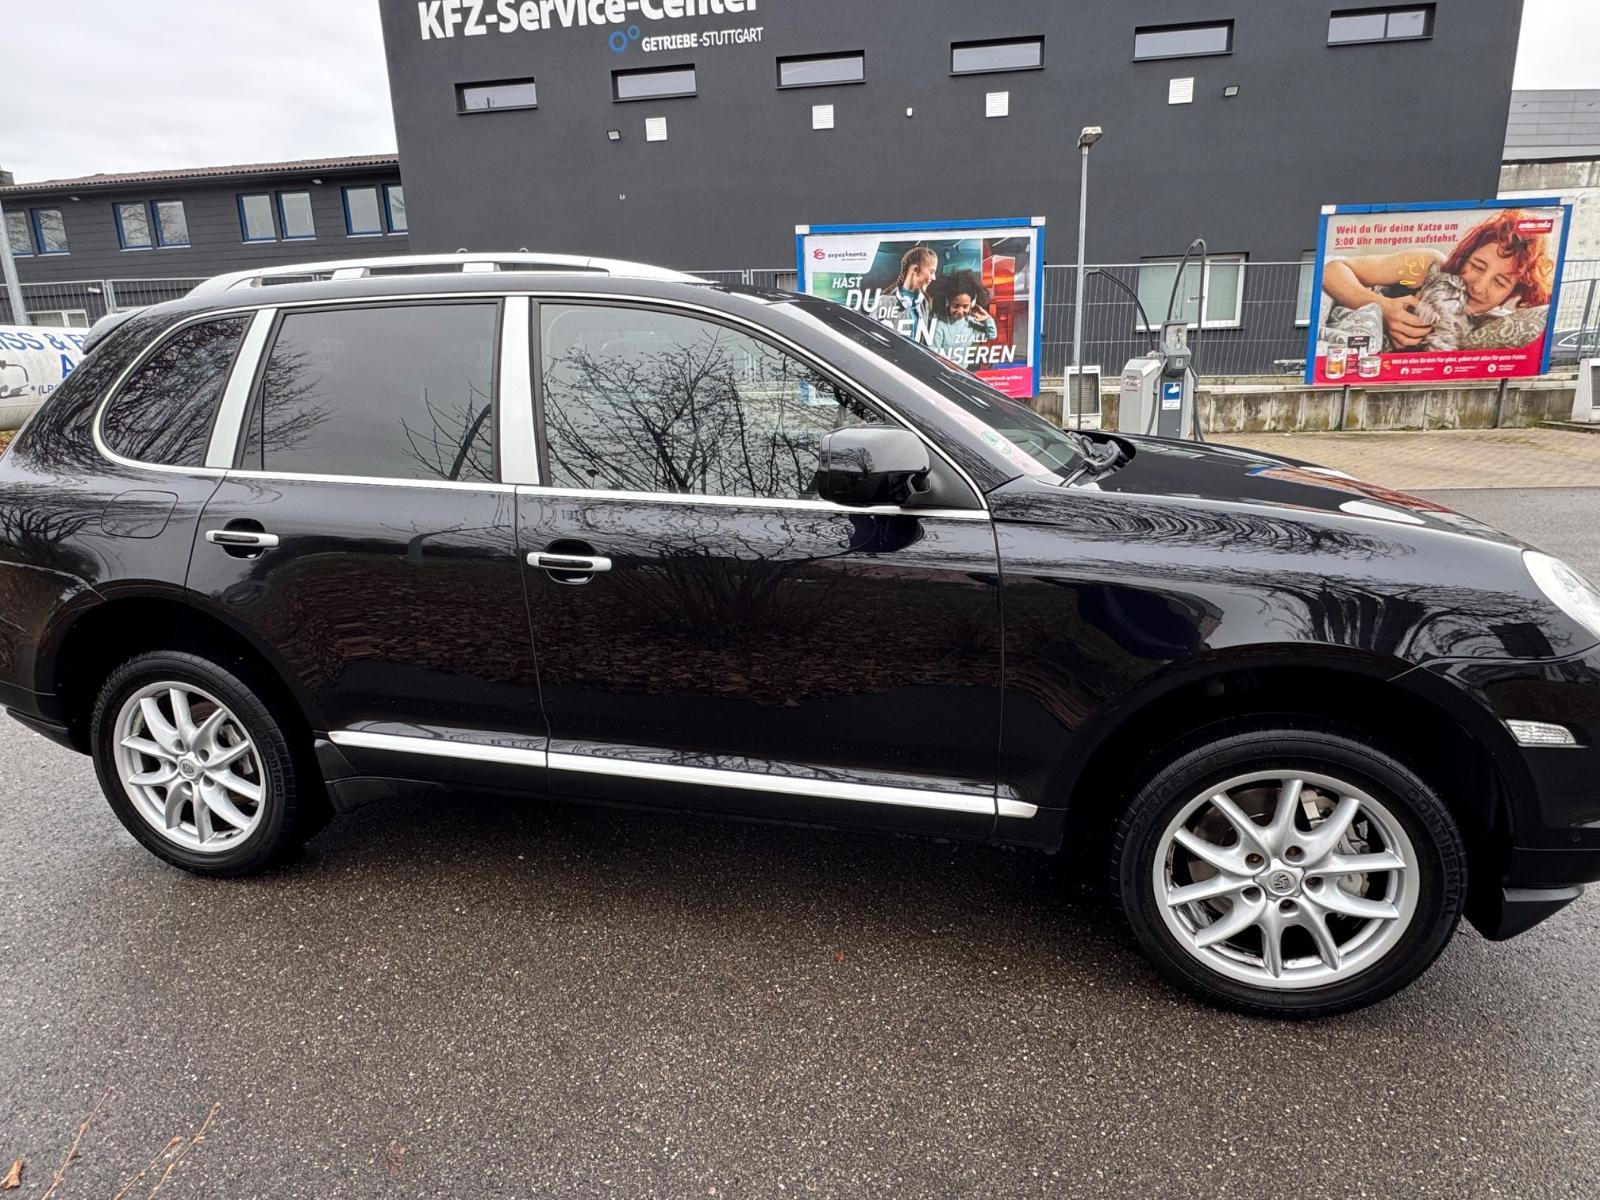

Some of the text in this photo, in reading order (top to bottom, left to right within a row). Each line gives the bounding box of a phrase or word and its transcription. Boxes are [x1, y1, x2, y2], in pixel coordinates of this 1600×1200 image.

[1336, 225, 1357, 234] Weil
[1359, 225, 1371, 233] du
[1374, 224, 1387, 233] für
[1389, 223, 1414, 233] deine
[1417, 223, 1441, 232] Katze
[1335, 233, 1459, 246] 5:00 Uhr morgens aufstehst.
[832, 276, 863, 289] HAST
[845, 287, 882, 313] DU
[878, 305, 901, 319] DIE
[880, 317, 938, 345] EN
[955, 332, 988, 343] ZU ALL
